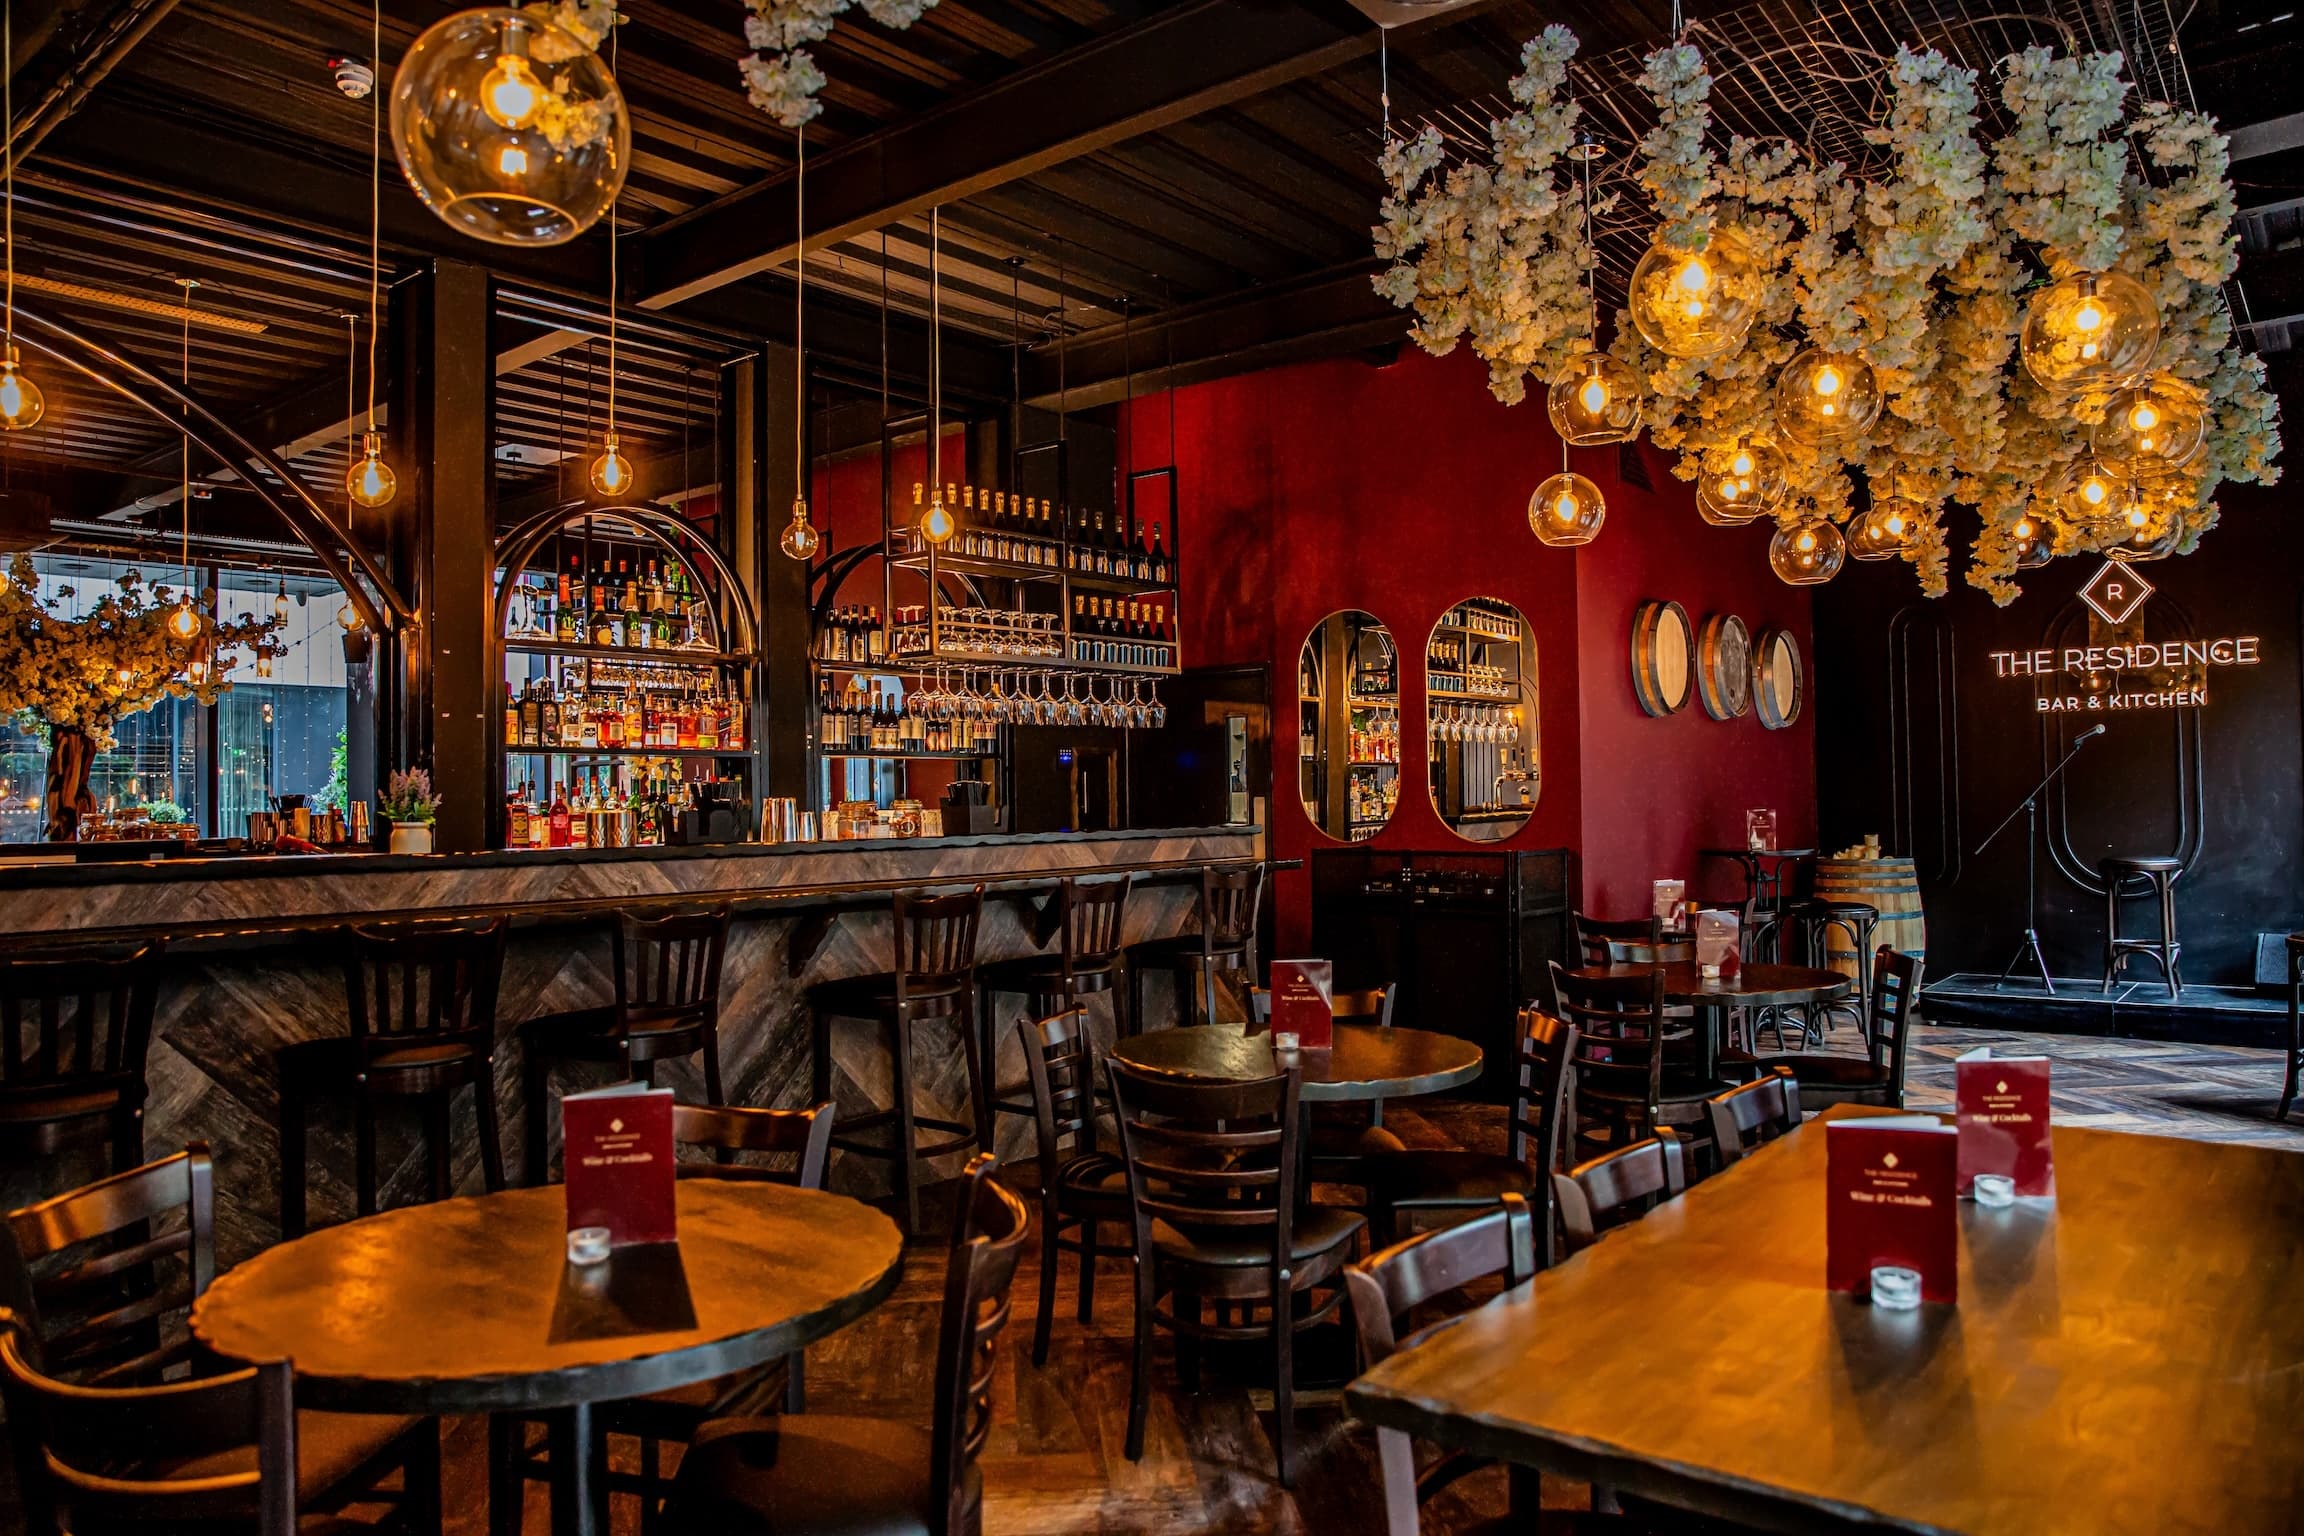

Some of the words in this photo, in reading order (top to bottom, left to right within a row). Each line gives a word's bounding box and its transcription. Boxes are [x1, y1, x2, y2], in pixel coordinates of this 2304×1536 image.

[2107, 583, 2123, 600] R
[1990, 649, 2053, 676] THE
[2064, 637, 2259, 672] RESIDENCE
[2037, 696, 2079, 711] BAR
[2087, 695, 2101, 709] &
[2109, 690, 2206, 709] KITCHEN
